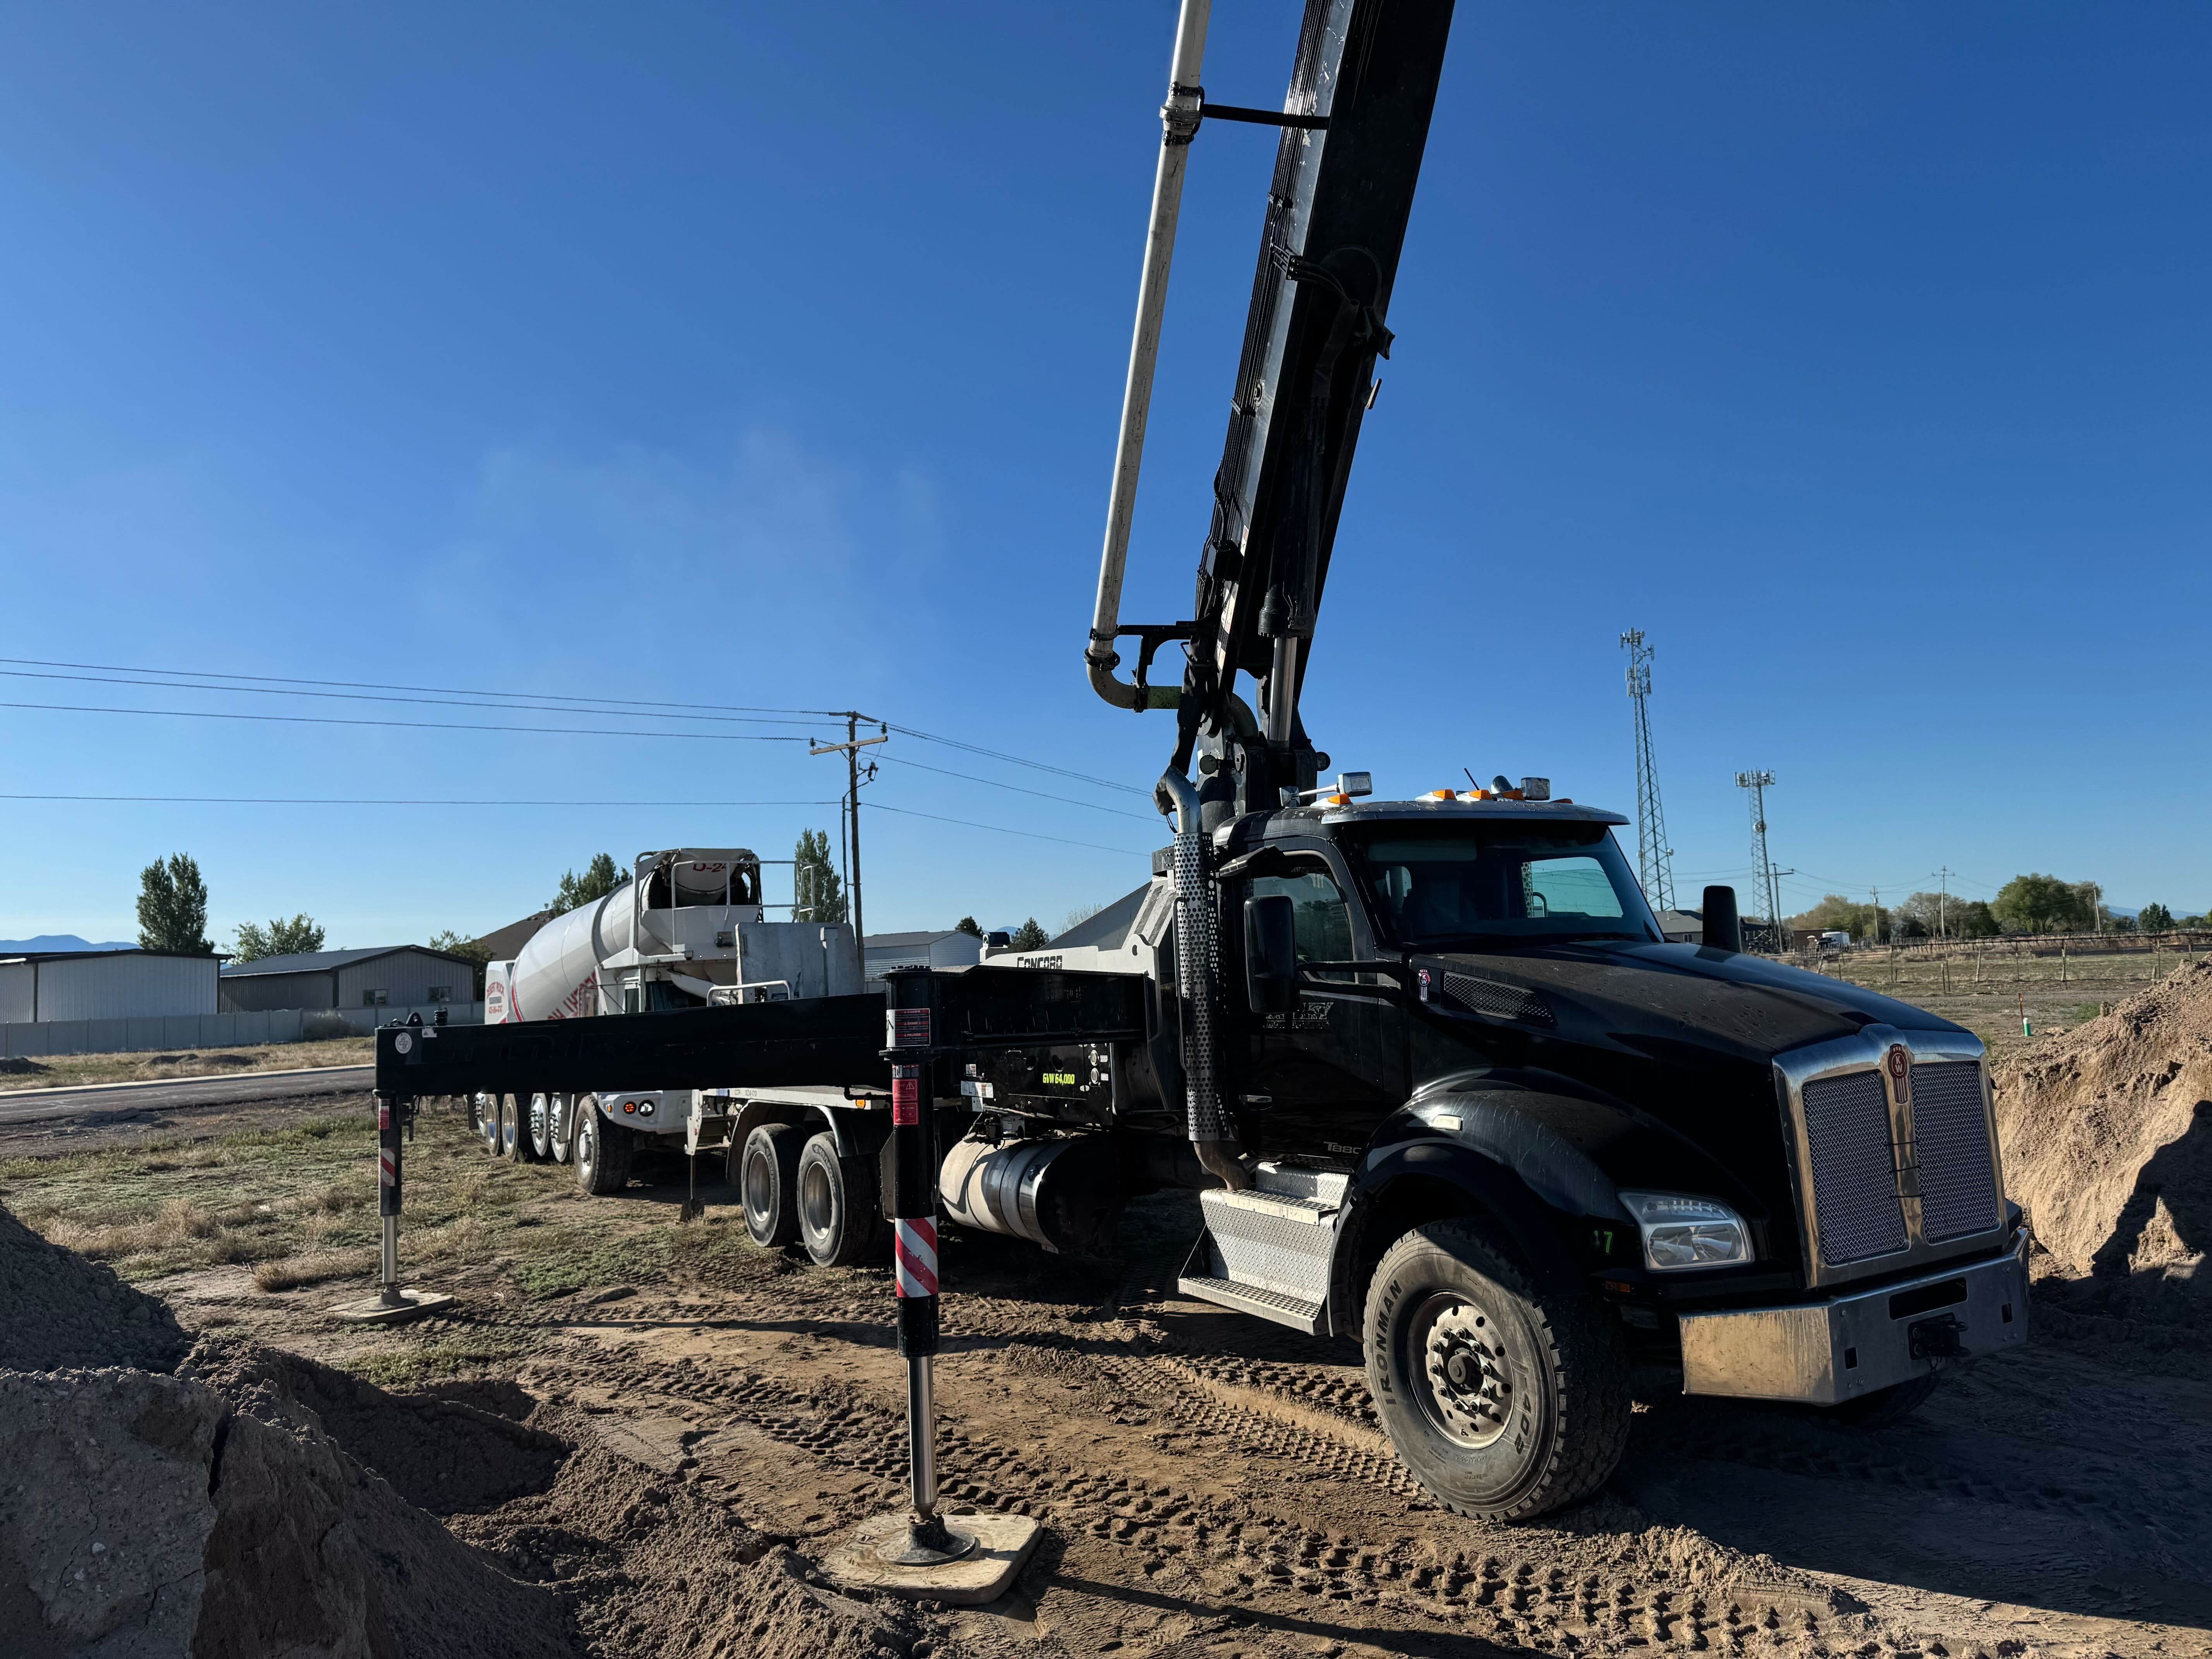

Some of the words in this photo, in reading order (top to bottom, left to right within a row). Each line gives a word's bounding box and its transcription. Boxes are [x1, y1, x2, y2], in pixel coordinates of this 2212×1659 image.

[1042, 1073, 1055, 1084] GVW
[1055, 1073, 1075, 1087] 64,000
[1376, 1279, 1402, 1405] IRONMAN
